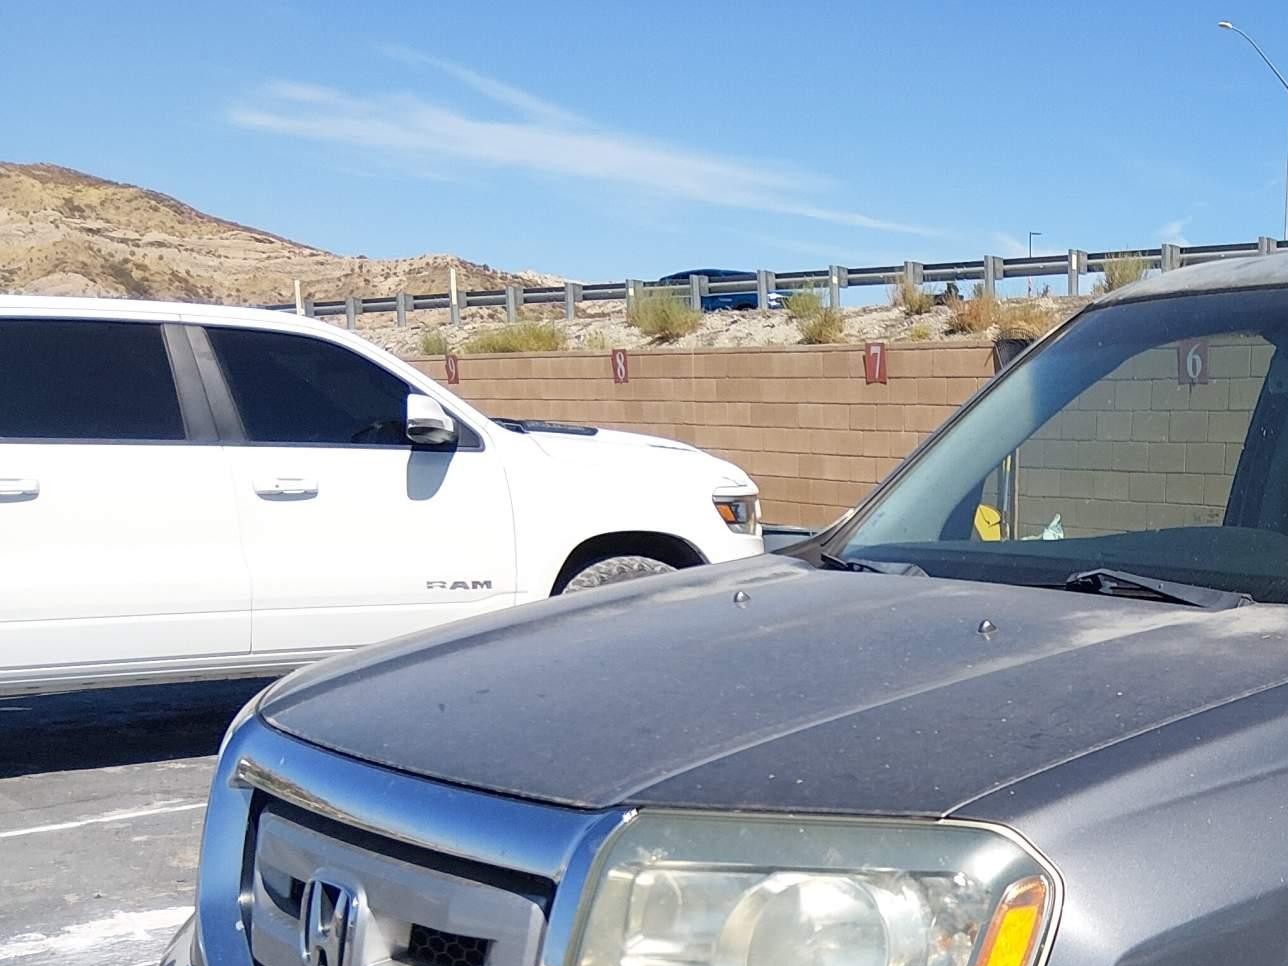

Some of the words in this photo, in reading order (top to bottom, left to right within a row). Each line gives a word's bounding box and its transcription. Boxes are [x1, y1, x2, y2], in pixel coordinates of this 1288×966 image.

[449, 358, 456, 381] 9
[616, 351, 625, 379] 8
[870, 345, 881, 379] 7
[1186, 343, 1202, 378] 6
[425, 580, 493, 590] RAM
